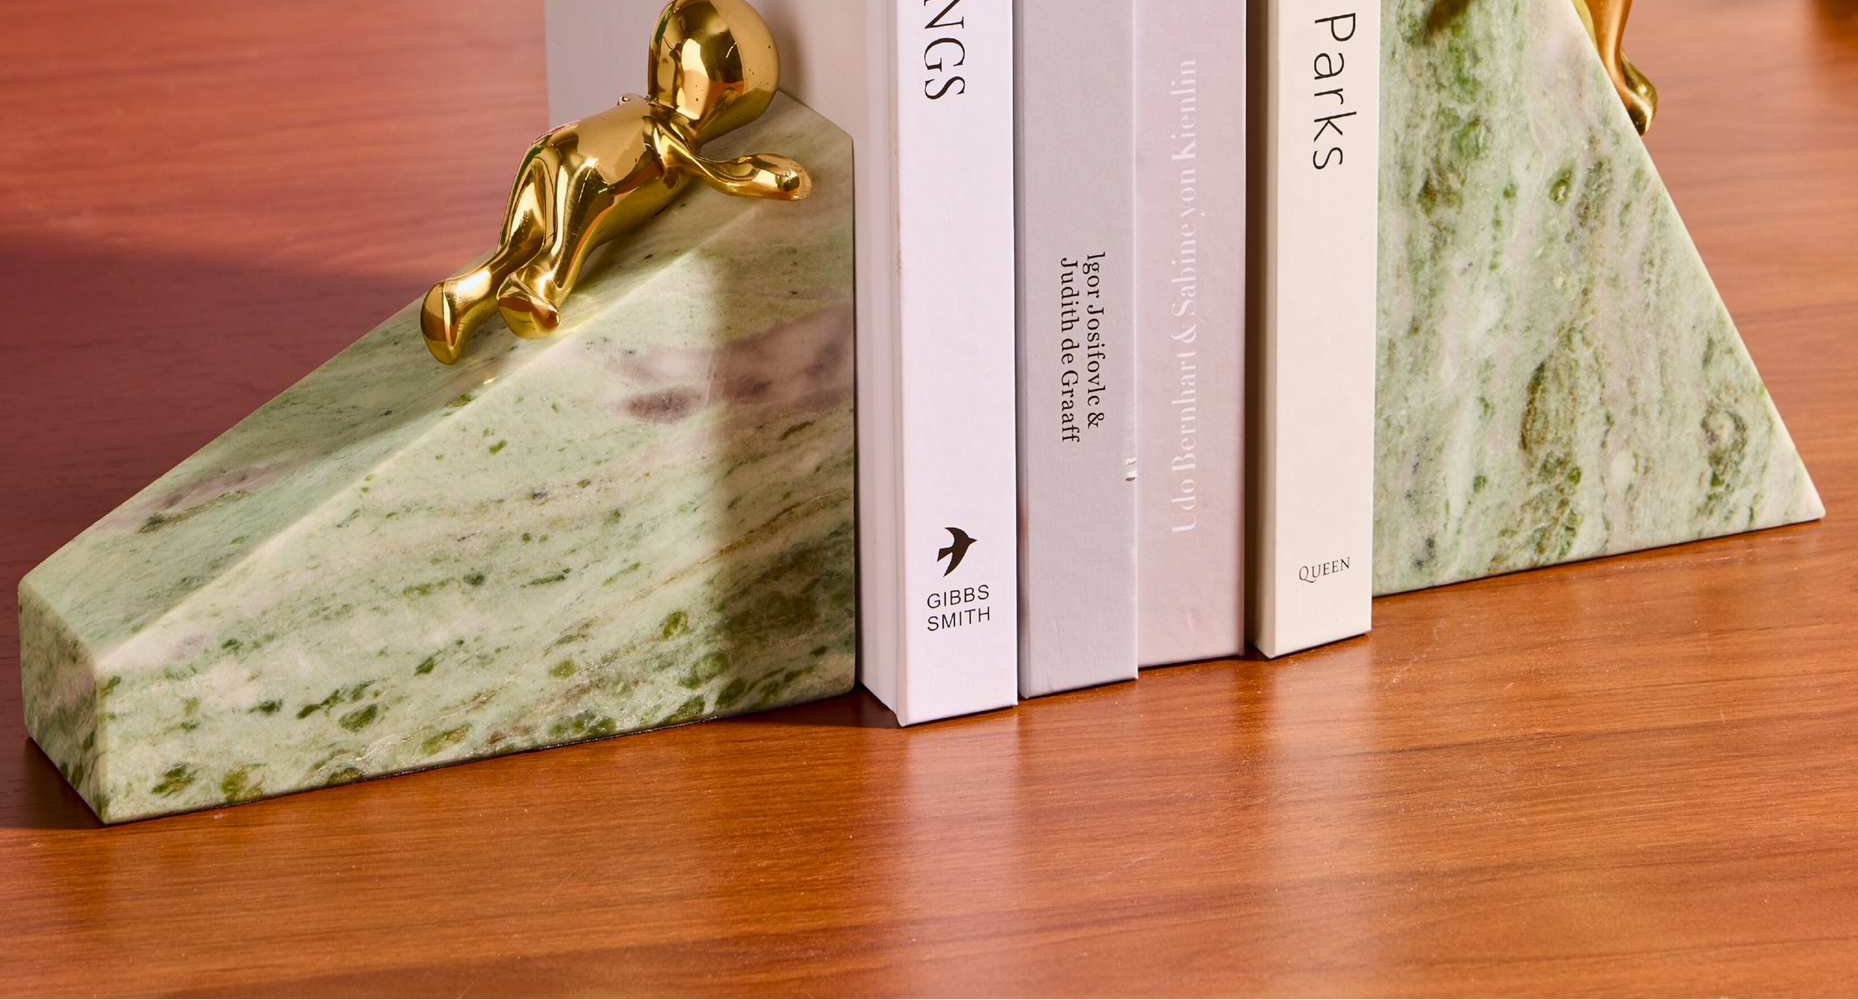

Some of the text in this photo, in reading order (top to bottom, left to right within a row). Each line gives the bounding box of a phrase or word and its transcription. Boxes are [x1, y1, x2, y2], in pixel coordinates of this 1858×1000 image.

[1171, 59, 1197, 162] Kienlin
[1312, 12, 1358, 170] Parks
[1171, 222, 1198, 317] Sabine
[1060, 257, 1081, 444] Judith de Graaff
[1171, 322, 1197, 344] &
[1086, 411, 1105, 430] &
[1171, 349, 1198, 471] Bernhart
[1171, 478, 1197, 534] Udo
[926, 584, 990, 609] GIBBS
[1298, 556, 1351, 584] QUEEN
[926, 607, 991, 632] SMITH
